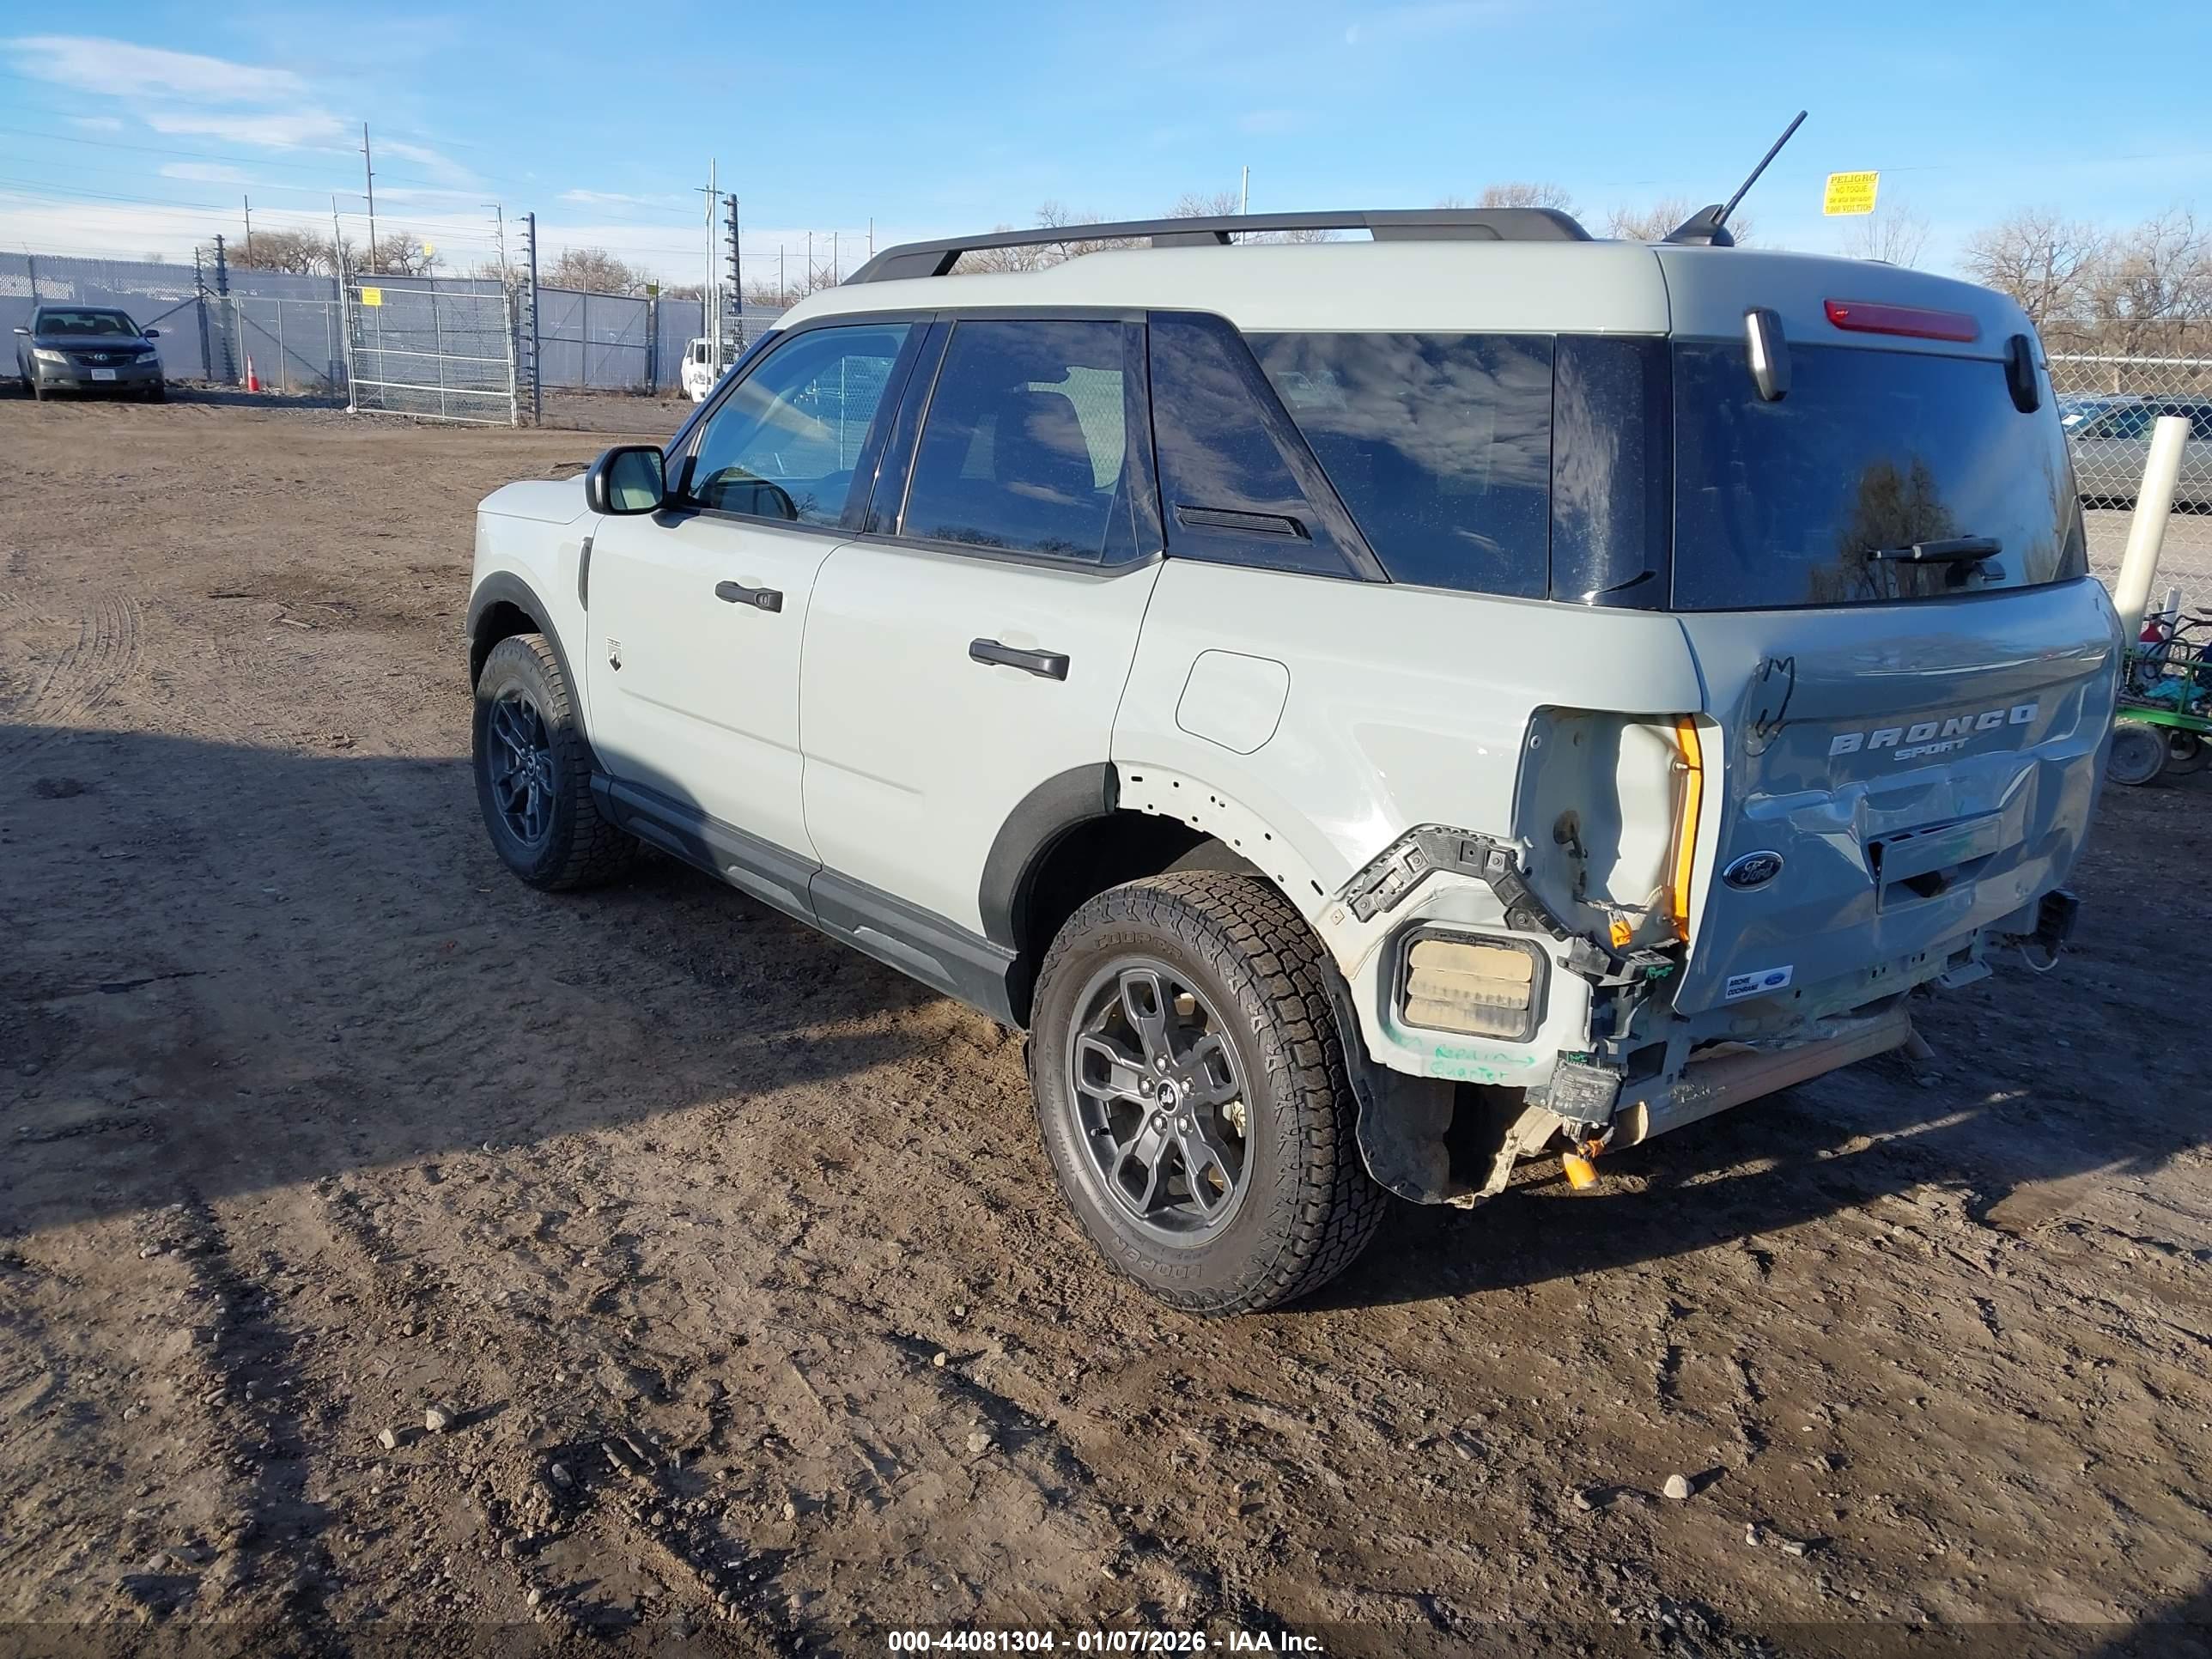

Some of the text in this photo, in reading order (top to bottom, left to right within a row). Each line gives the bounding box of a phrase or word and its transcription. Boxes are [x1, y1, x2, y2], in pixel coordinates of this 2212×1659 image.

[1830, 173, 1876, 184] PELIGRO
[1828, 703, 2039, 757] BRONCO
[1893, 737, 1970, 762] SPORT
